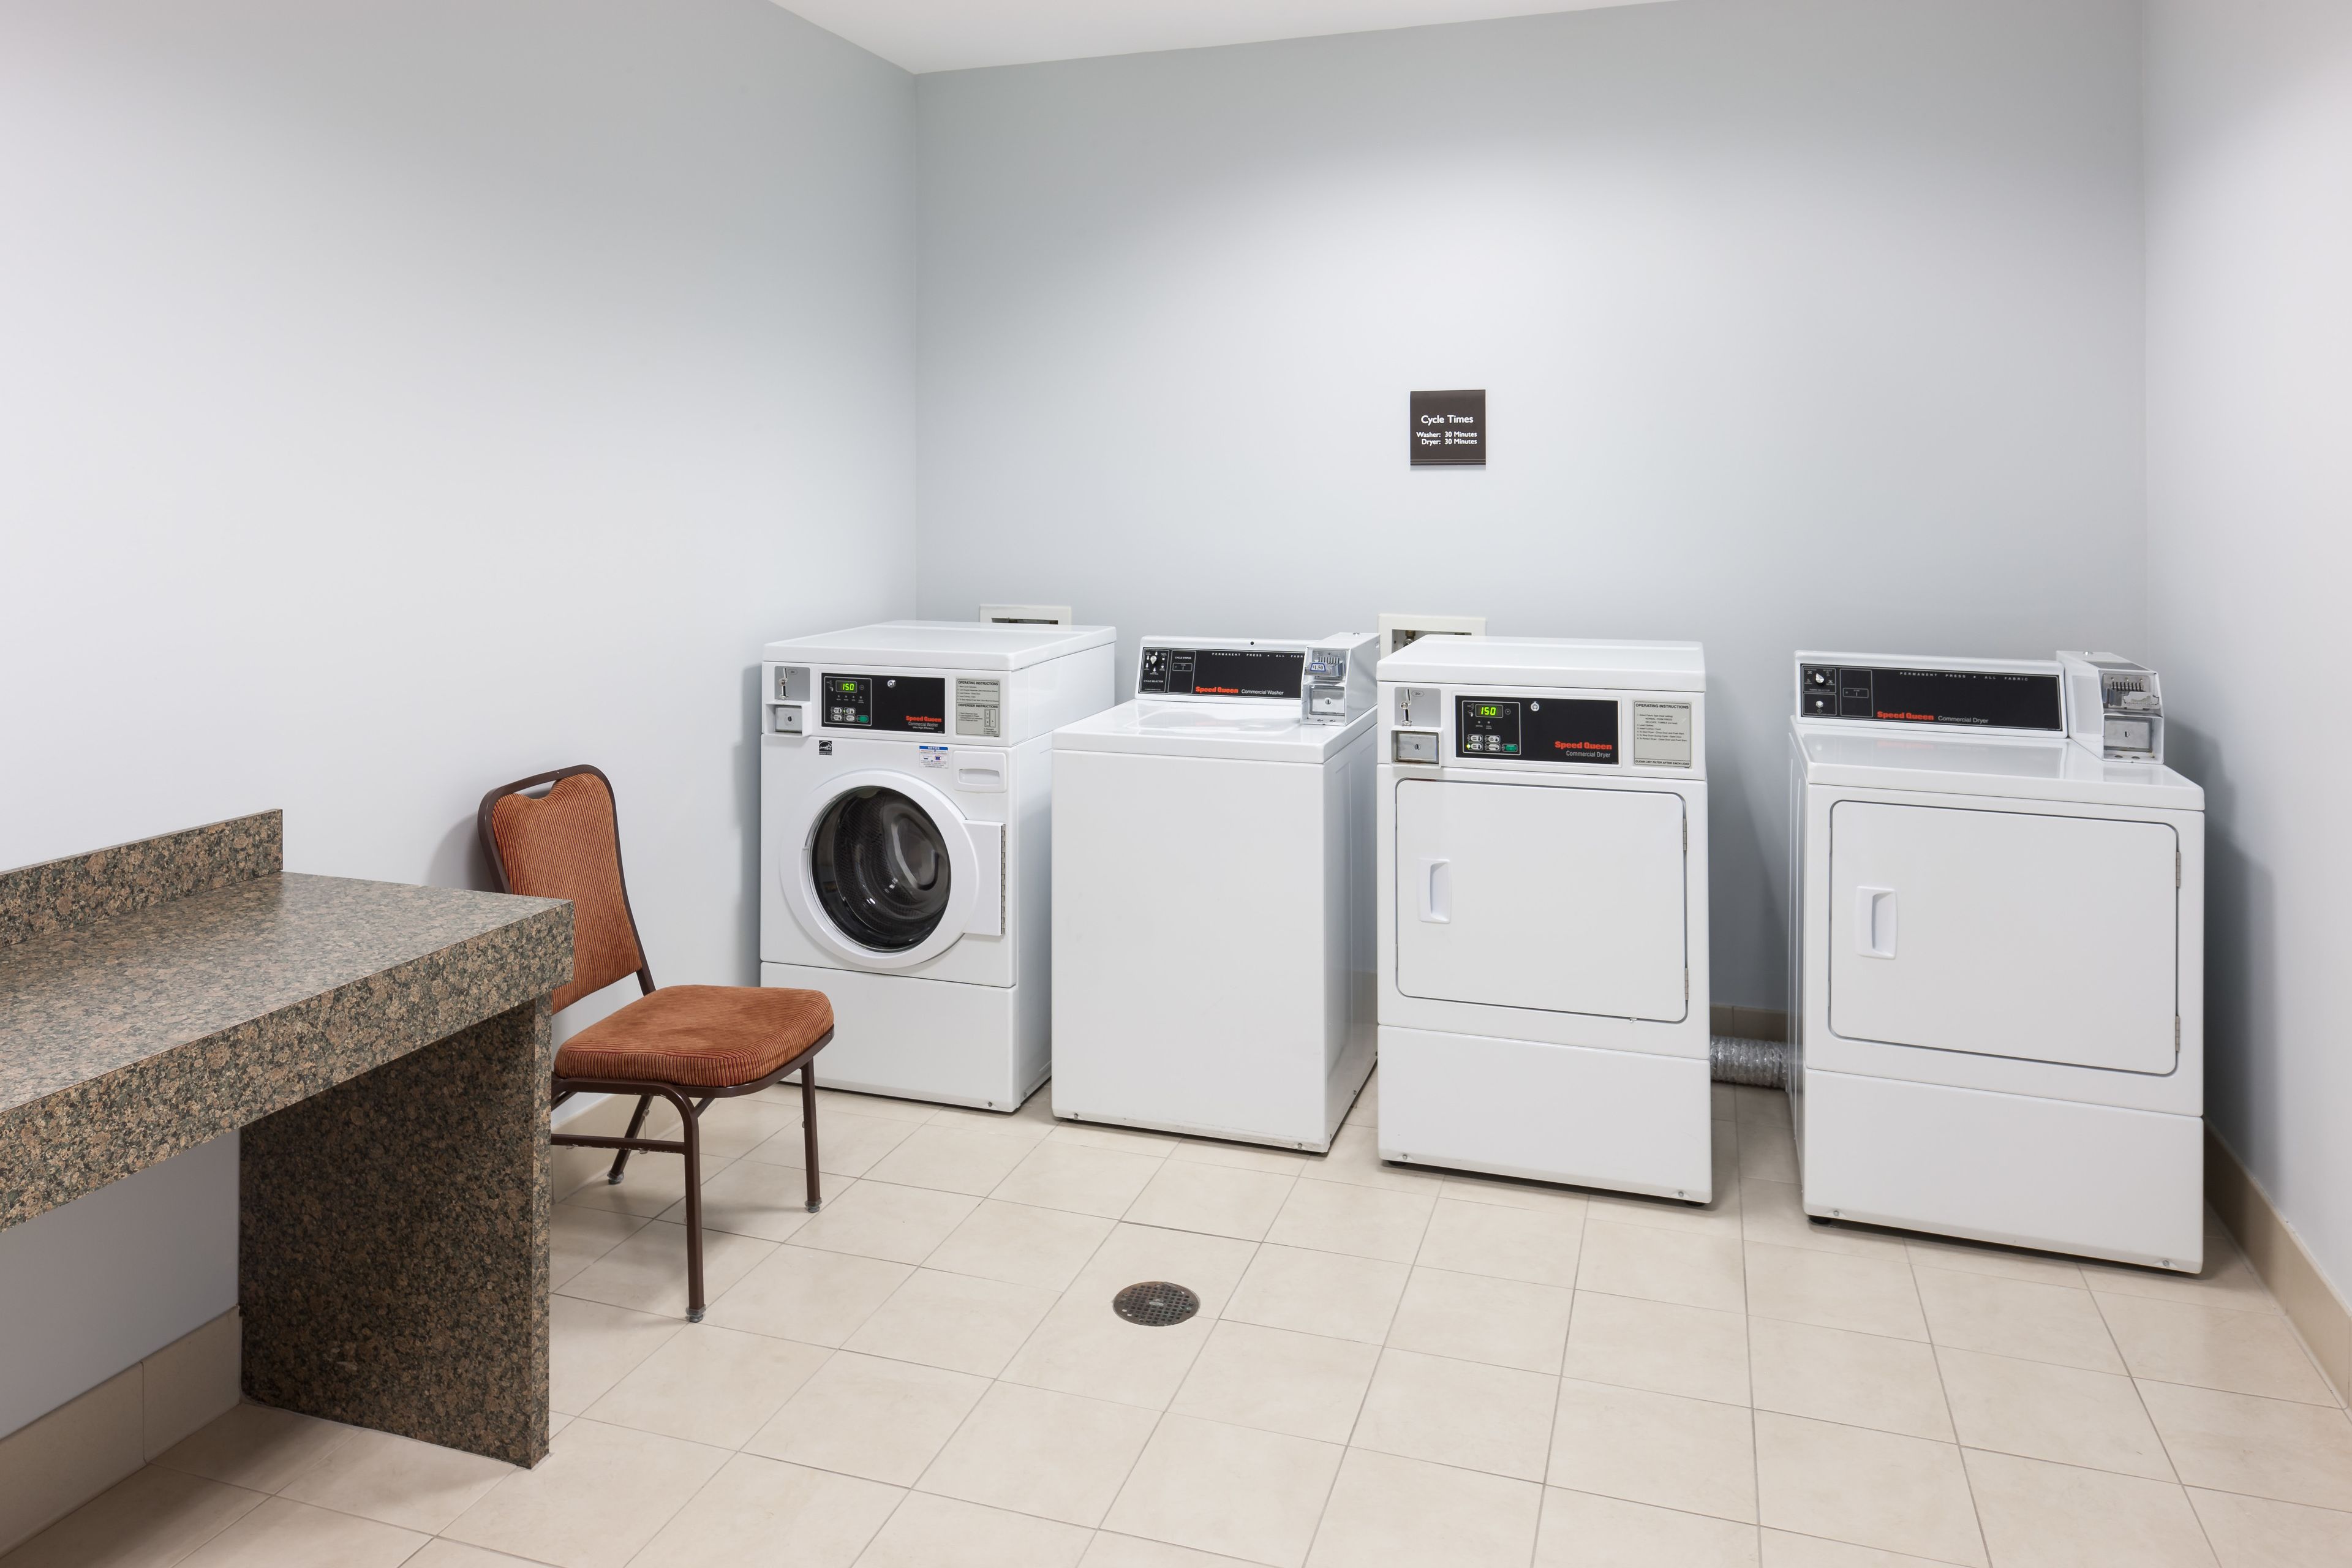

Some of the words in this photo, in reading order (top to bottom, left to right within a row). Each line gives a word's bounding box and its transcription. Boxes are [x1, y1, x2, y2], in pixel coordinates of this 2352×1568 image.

[1421, 415, 1445, 426] Cycle
[1447, 415, 1474, 423] Times
[1480, 707, 1496, 715] 150
[1555, 741, 1583, 749] Speed
